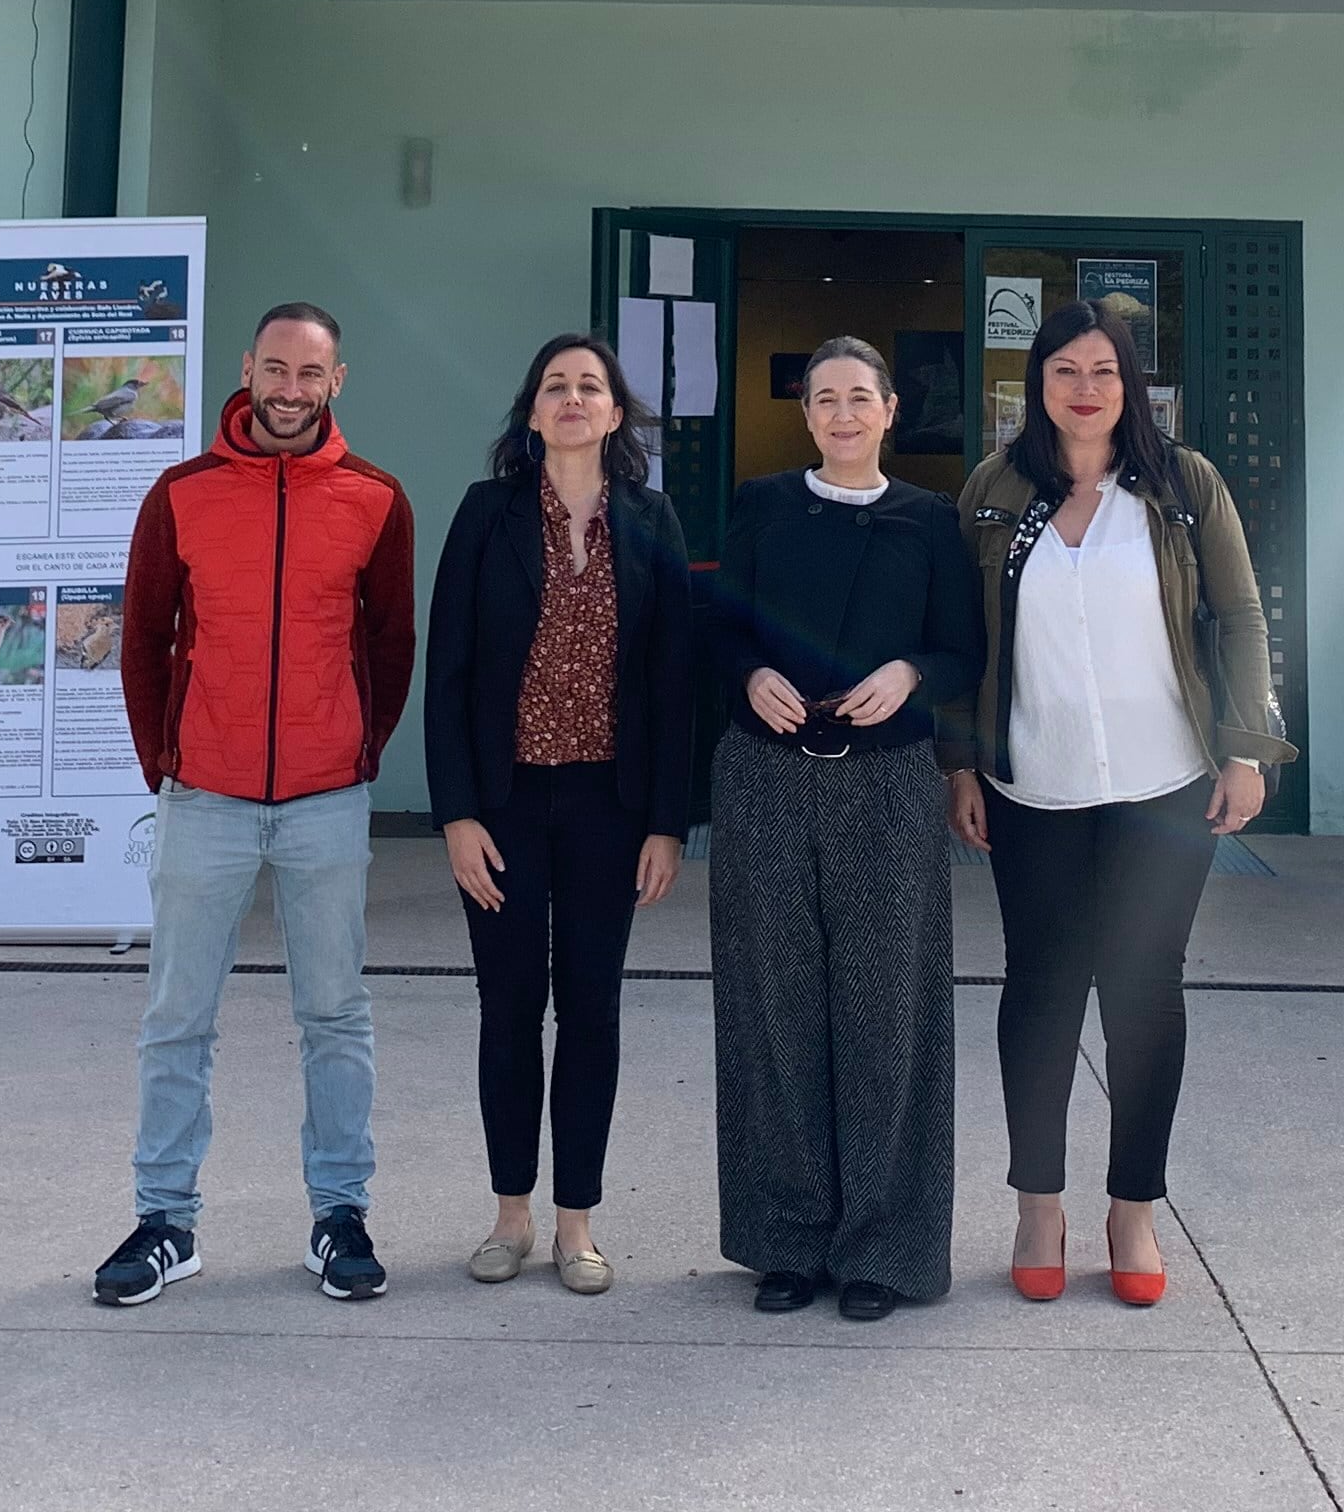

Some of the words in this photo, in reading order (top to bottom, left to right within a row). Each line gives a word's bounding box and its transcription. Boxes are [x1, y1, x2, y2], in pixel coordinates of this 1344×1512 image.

[15, 280, 108, 292] NUESTRAS
[39, 291, 84, 300] AVES
[39, 331, 53, 342] 17
[171, 328, 185, 339] 18
[16, 552, 54, 561] ESCANEA
[55, 552, 76, 560] ESTE
[44, 563, 71, 571] CANTO
[86, 562, 108, 570] CADA
[31, 590, 45, 601] 19
